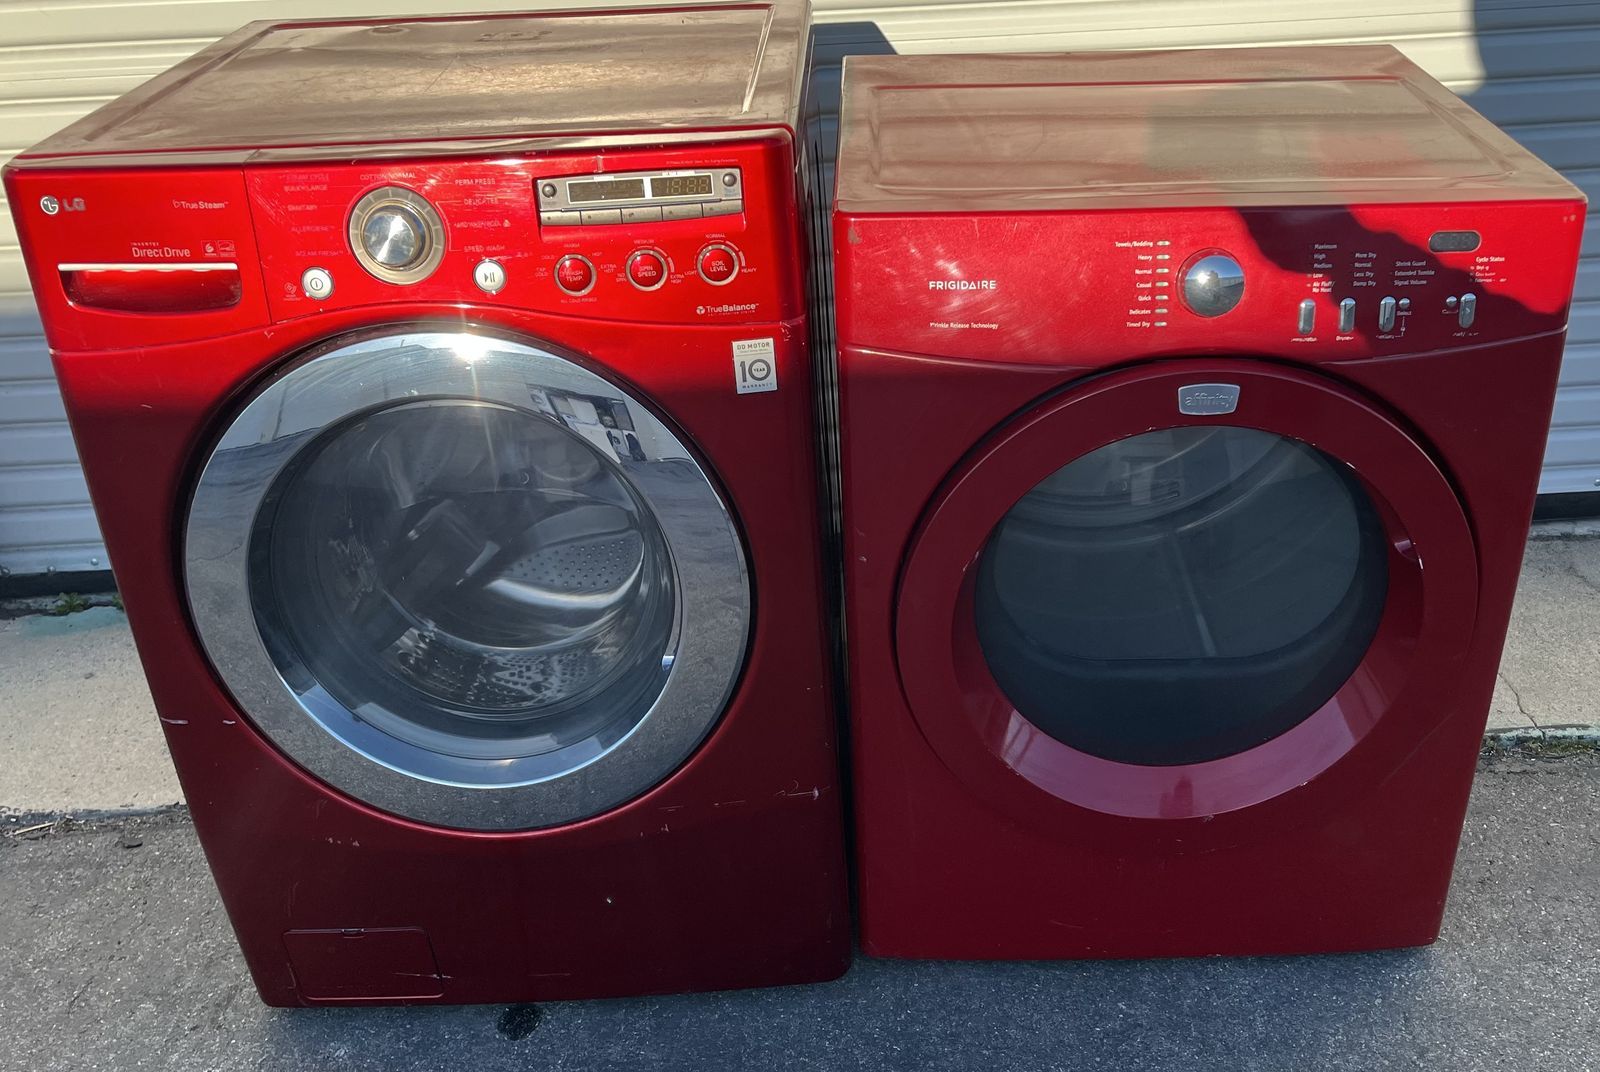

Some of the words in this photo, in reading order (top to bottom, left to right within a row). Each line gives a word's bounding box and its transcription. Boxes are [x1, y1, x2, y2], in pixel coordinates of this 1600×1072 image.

[62, 198, 86, 211] LG
[132, 247, 163, 257] Direct
[164, 247, 190, 257] Drive
[929, 280, 996, 290] FRIGIDAIRE
[706, 304, 756, 313] TrueBalance
[970, 322, 998, 330] Technology
[747, 342, 770, 350] MOTOR
[740, 359, 771, 382] 10
